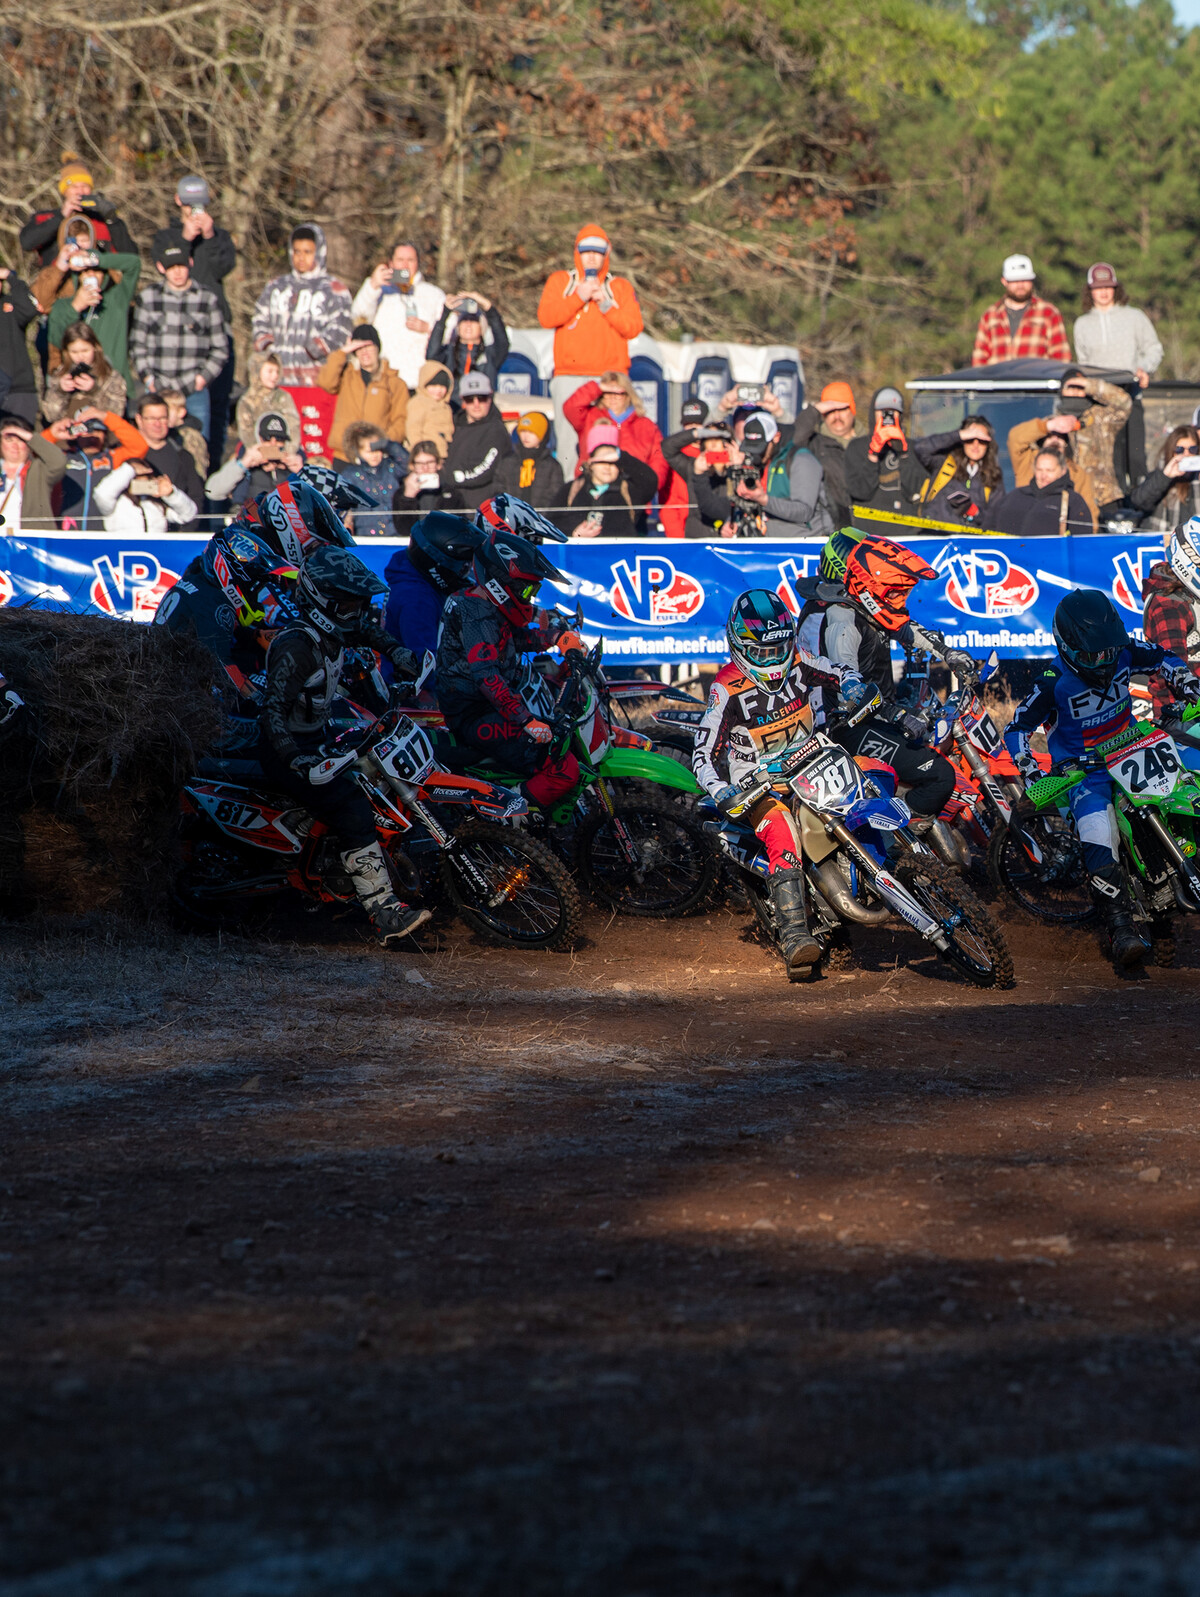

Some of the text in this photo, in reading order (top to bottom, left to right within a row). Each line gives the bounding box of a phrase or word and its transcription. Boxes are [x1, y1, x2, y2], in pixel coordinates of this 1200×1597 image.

[945, 548, 1010, 613] VP
[1174, 557, 1190, 578] 488
[92, 550, 161, 616] VP
[227, 588, 243, 605] 010
[489, 582, 504, 602] 474
[610, 555, 675, 619] VP
[862, 596, 876, 612] 161
[311, 612, 332, 631] 039
[762, 629, 793, 642] LEATT
[972, 710, 1001, 755] 10
[1101, 727, 1141, 754] RENTHA
[392, 730, 430, 780] 817
[785, 738, 818, 767] RENTHAL
[860, 739, 894, 763] FLY
[809, 755, 854, 808] 287
[1120, 741, 1179, 794] 246
[214, 799, 262, 829] 817
